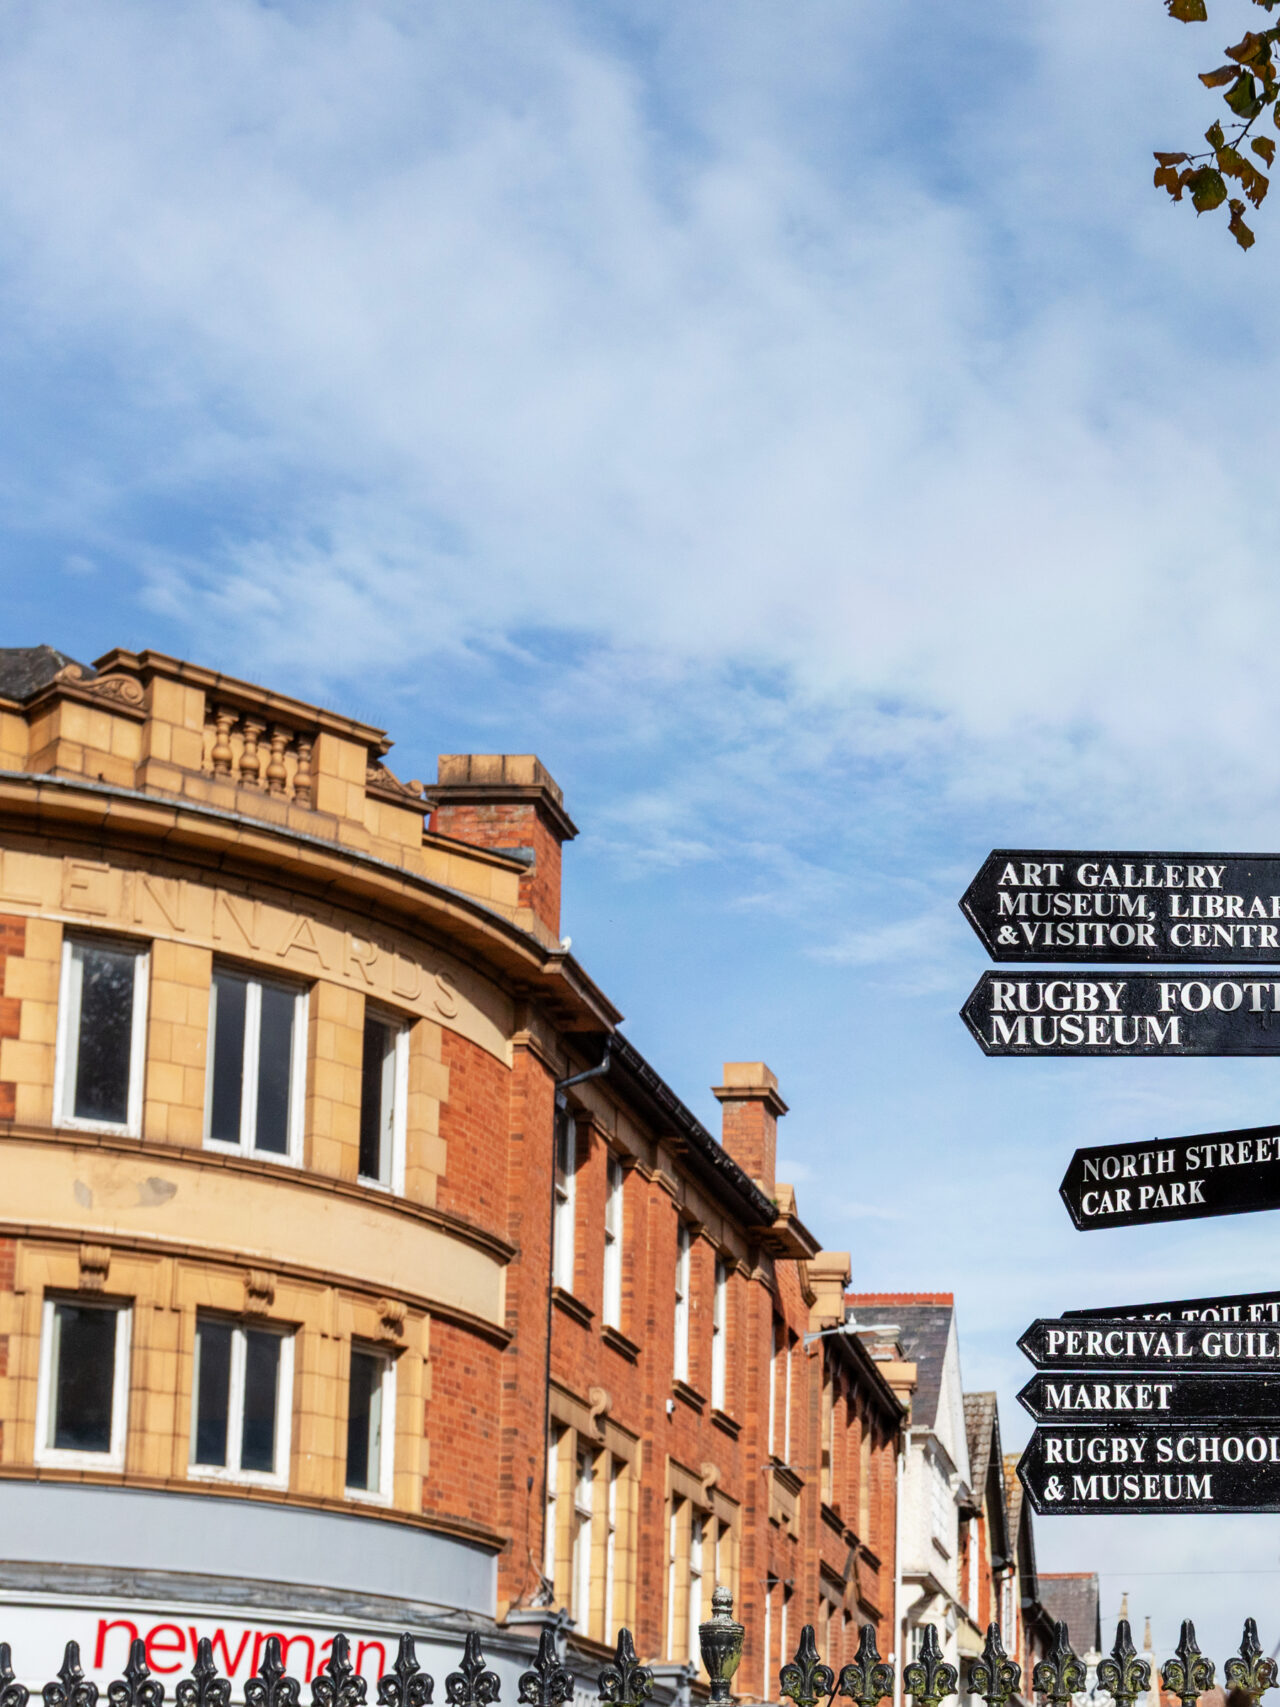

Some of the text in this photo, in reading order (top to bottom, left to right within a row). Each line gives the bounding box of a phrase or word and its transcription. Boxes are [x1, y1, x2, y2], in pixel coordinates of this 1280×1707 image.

[997, 862, 1228, 889] ART GALLERY
[997, 891, 1156, 922] MUSEUM,
[989, 980, 1128, 1013] RUGBY
[989, 1014, 1183, 1046] MUSEUM
[1082, 1149, 1176, 1182] NORTH
[1081, 1179, 1206, 1216] CAR PARK
[1046, 1329, 1194, 1357] PERCIVAL
[1044, 1384, 1173, 1410] MARKET
[1044, 1437, 1148, 1464] RUGBY
[1043, 1474, 1214, 1501] & MUSEUM
[94, 1619, 386, 1688] newman
